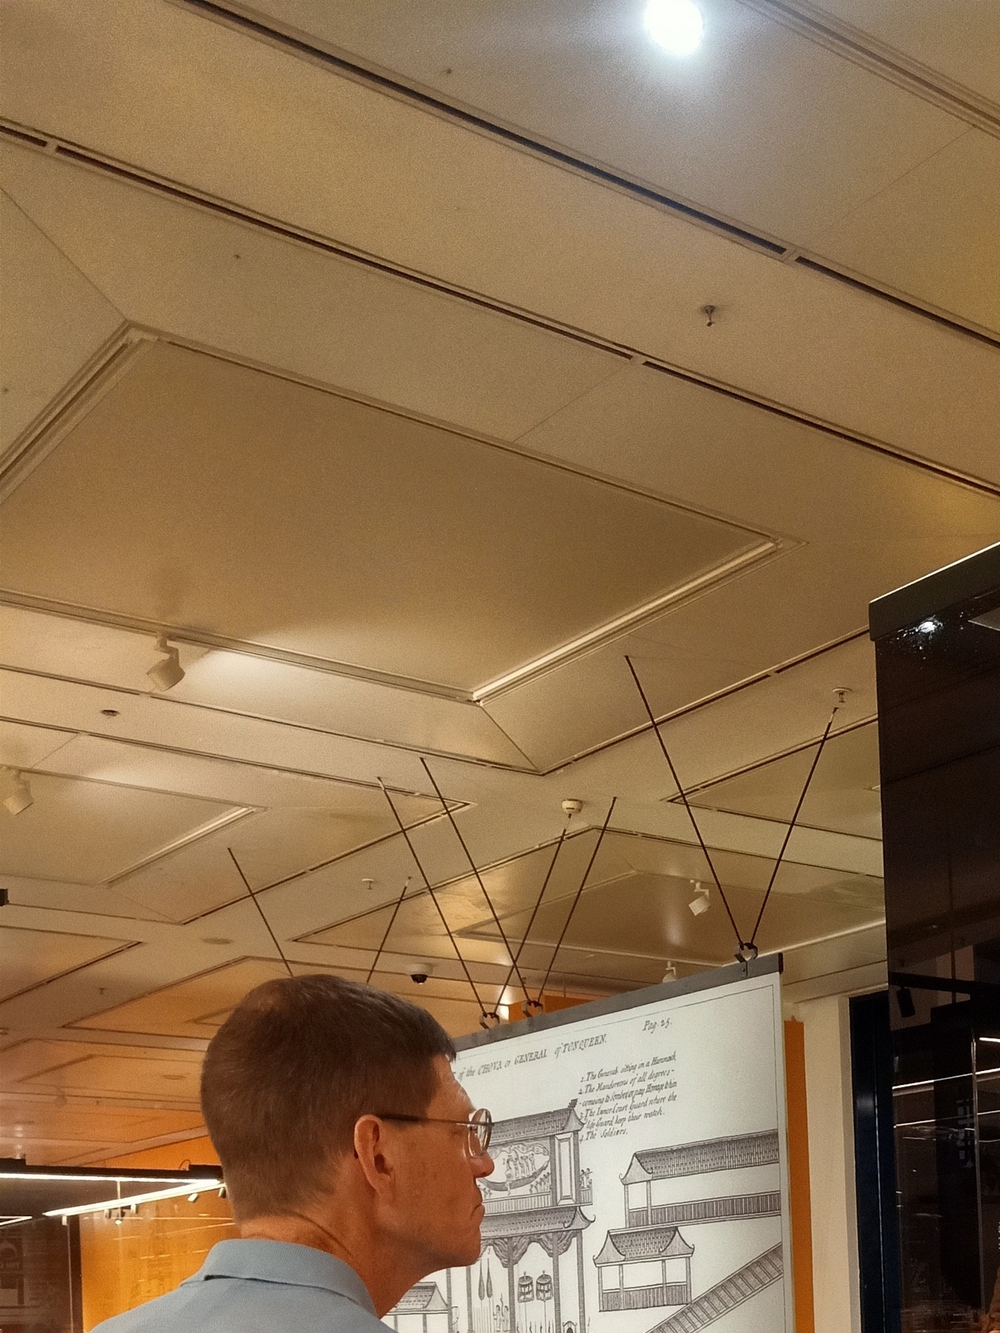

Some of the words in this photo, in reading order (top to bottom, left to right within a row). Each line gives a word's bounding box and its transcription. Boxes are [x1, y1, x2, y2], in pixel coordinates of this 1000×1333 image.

[466, 1066, 476, 1077] the
[514, 1049, 548, 1066] GENERAL
[584, 1083, 596, 1094] The
[637, 1071, 648, 1083] all
[586, 1070, 597, 1082] The
[584, 1107, 596, 1118] The
[667, 1091, 678, 1102] the
[585, 1129, 597, 1141] The
